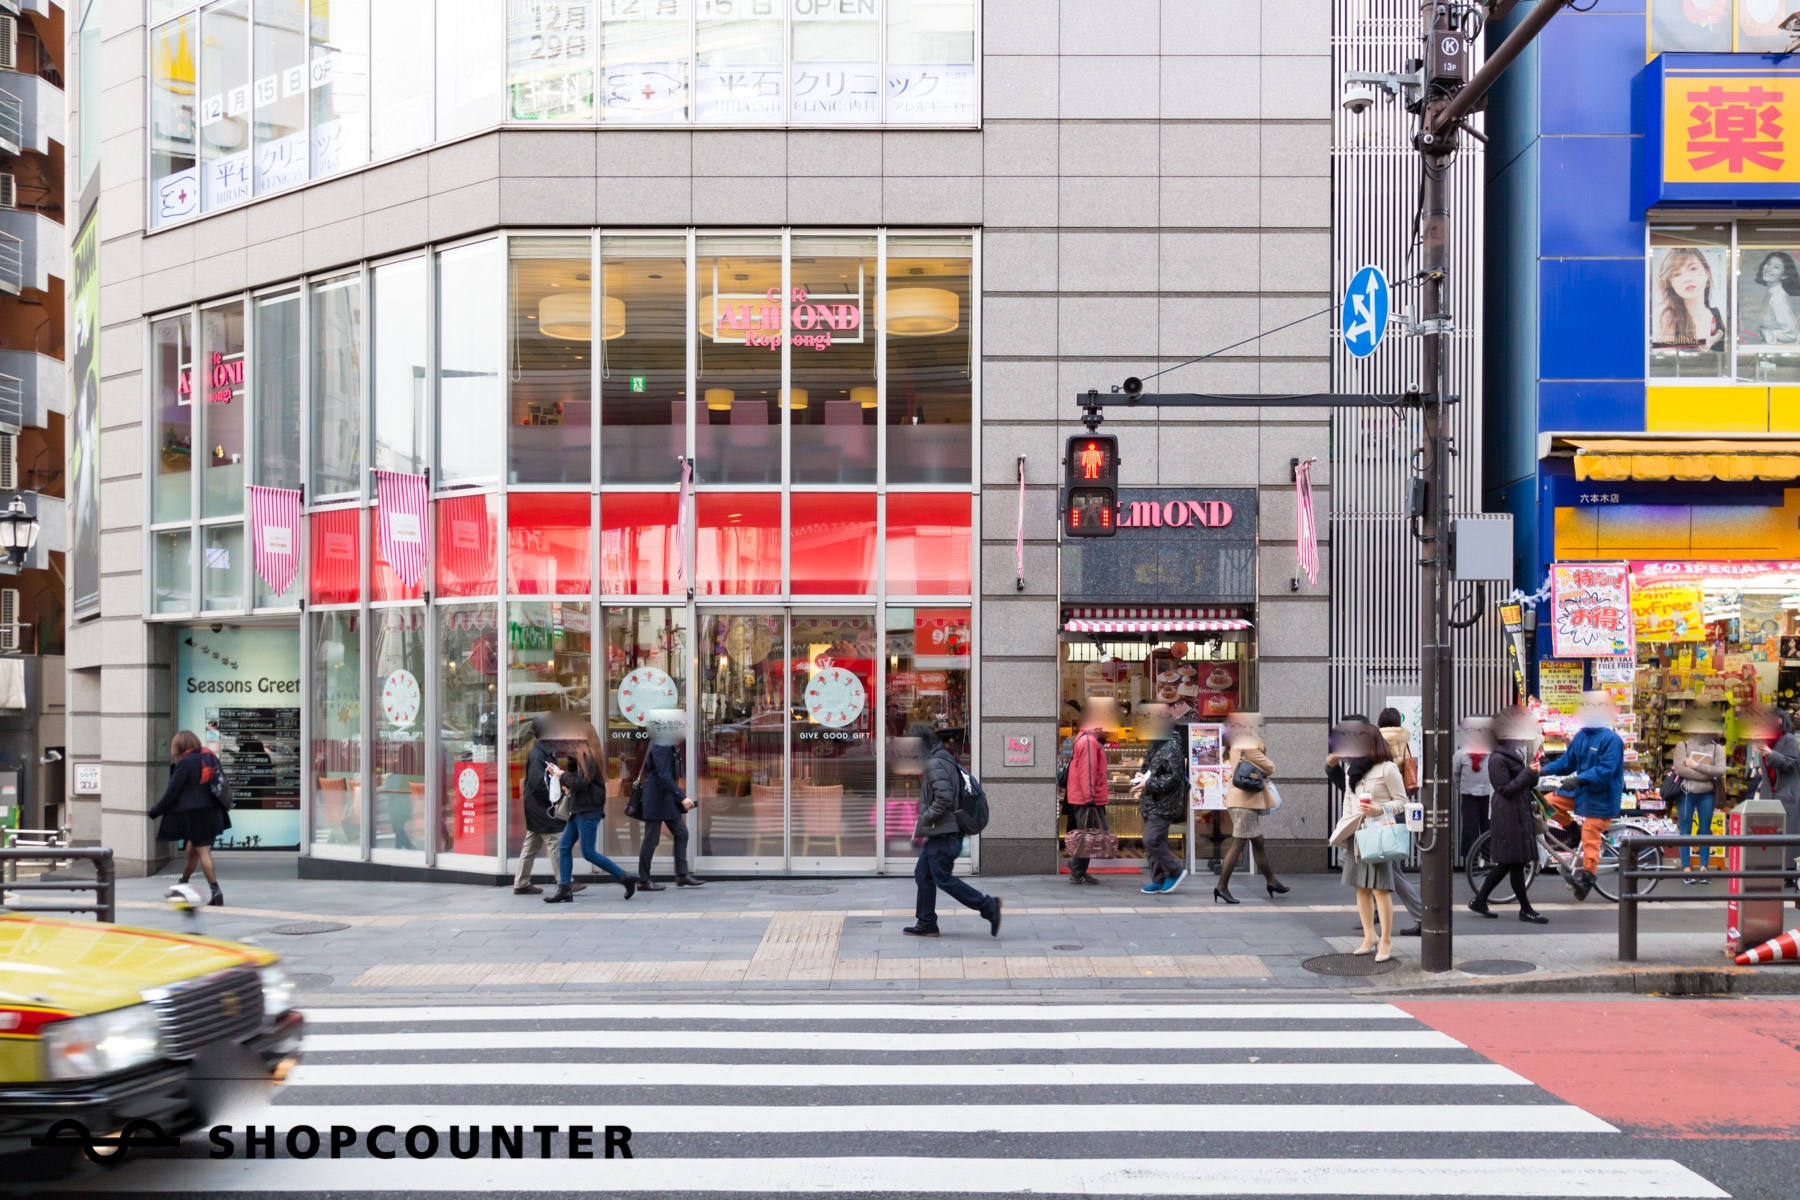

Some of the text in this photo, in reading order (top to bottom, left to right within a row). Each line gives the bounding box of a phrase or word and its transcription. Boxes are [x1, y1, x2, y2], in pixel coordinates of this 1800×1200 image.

[1686, 85, 1786, 173] 薬
[766, 286, 808, 303] Cfé
[744, 331, 832, 351] Ropongi
[1579, 493, 1620, 503] 六本木店
[1116, 500, 1233, 527] LMOND
[1571, 606, 1618, 631] お得
[186, 677, 253, 694] Seasons
[611, 731, 649, 739] GIVE GO
[462, 809, 476, 817] GOOD
